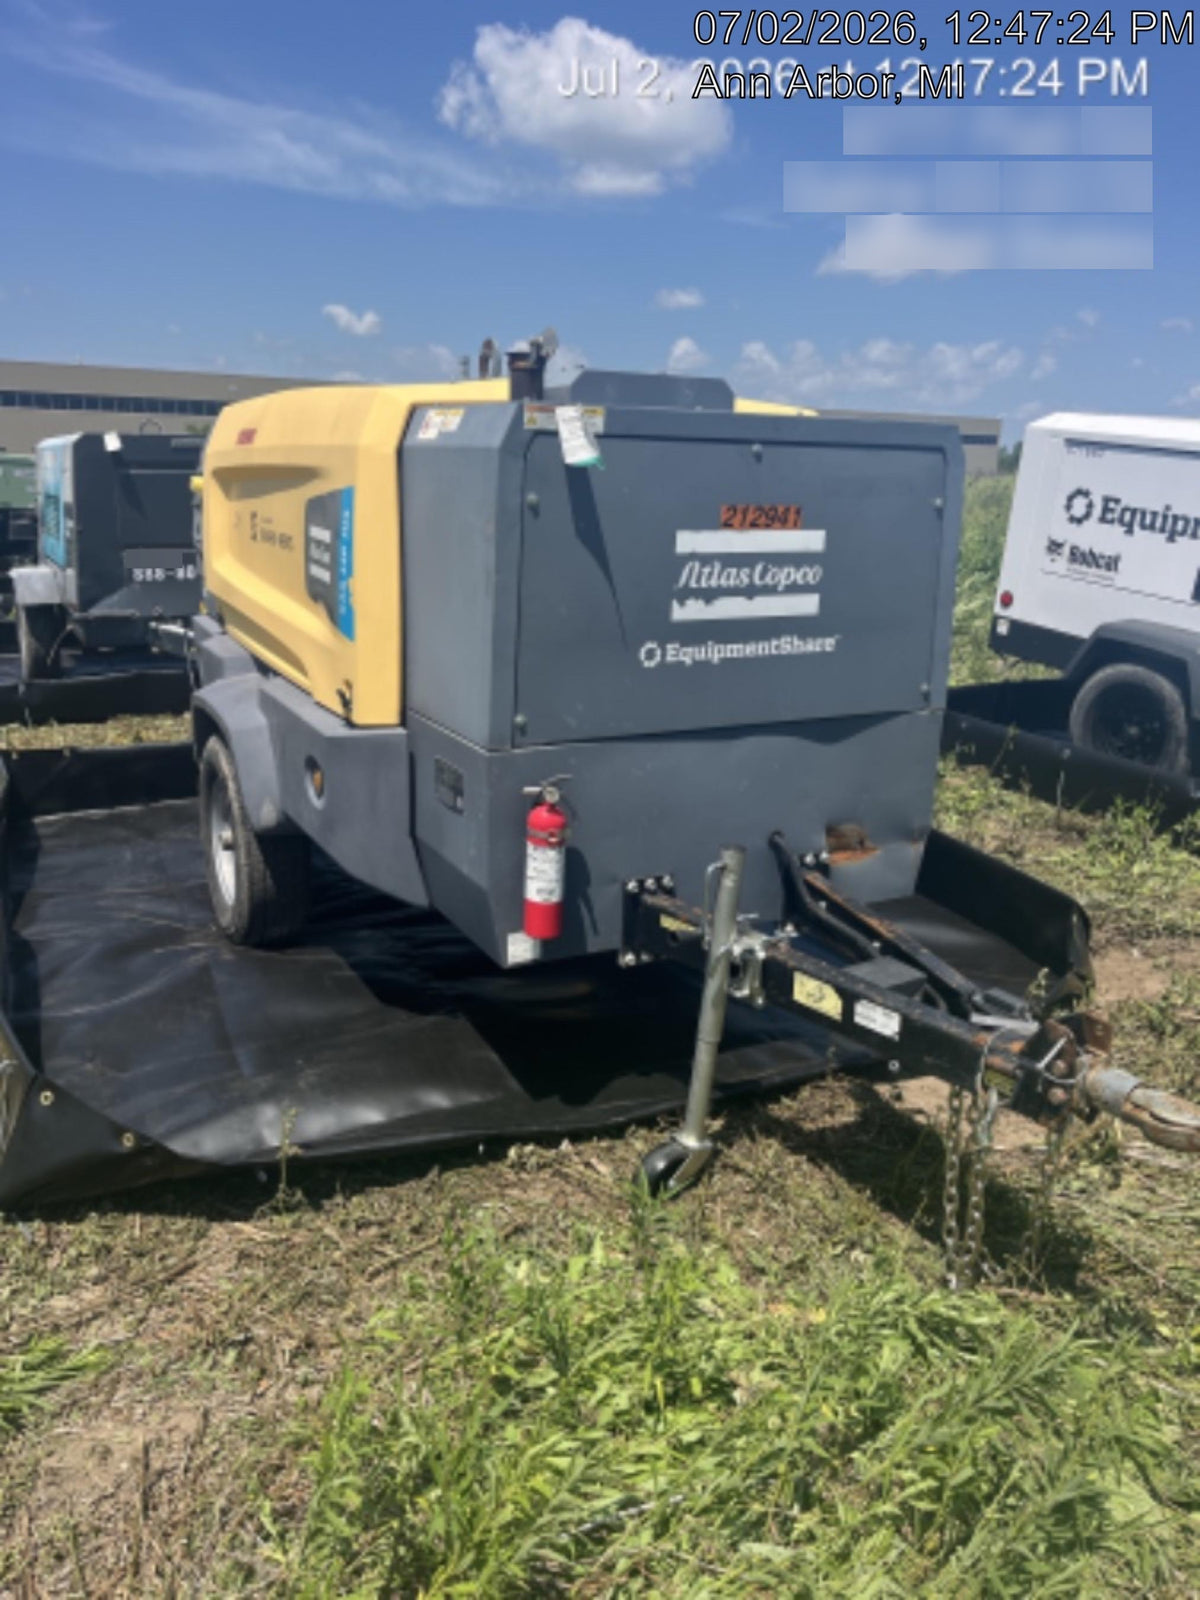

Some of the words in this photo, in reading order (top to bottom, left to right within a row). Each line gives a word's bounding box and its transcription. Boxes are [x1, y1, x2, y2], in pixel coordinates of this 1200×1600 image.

[721, 505, 802, 528] 212941
[674, 560, 749, 590] Atlas
[752, 561, 823, 592] Copco
[665, 635, 837, 666] EquipmentShare
